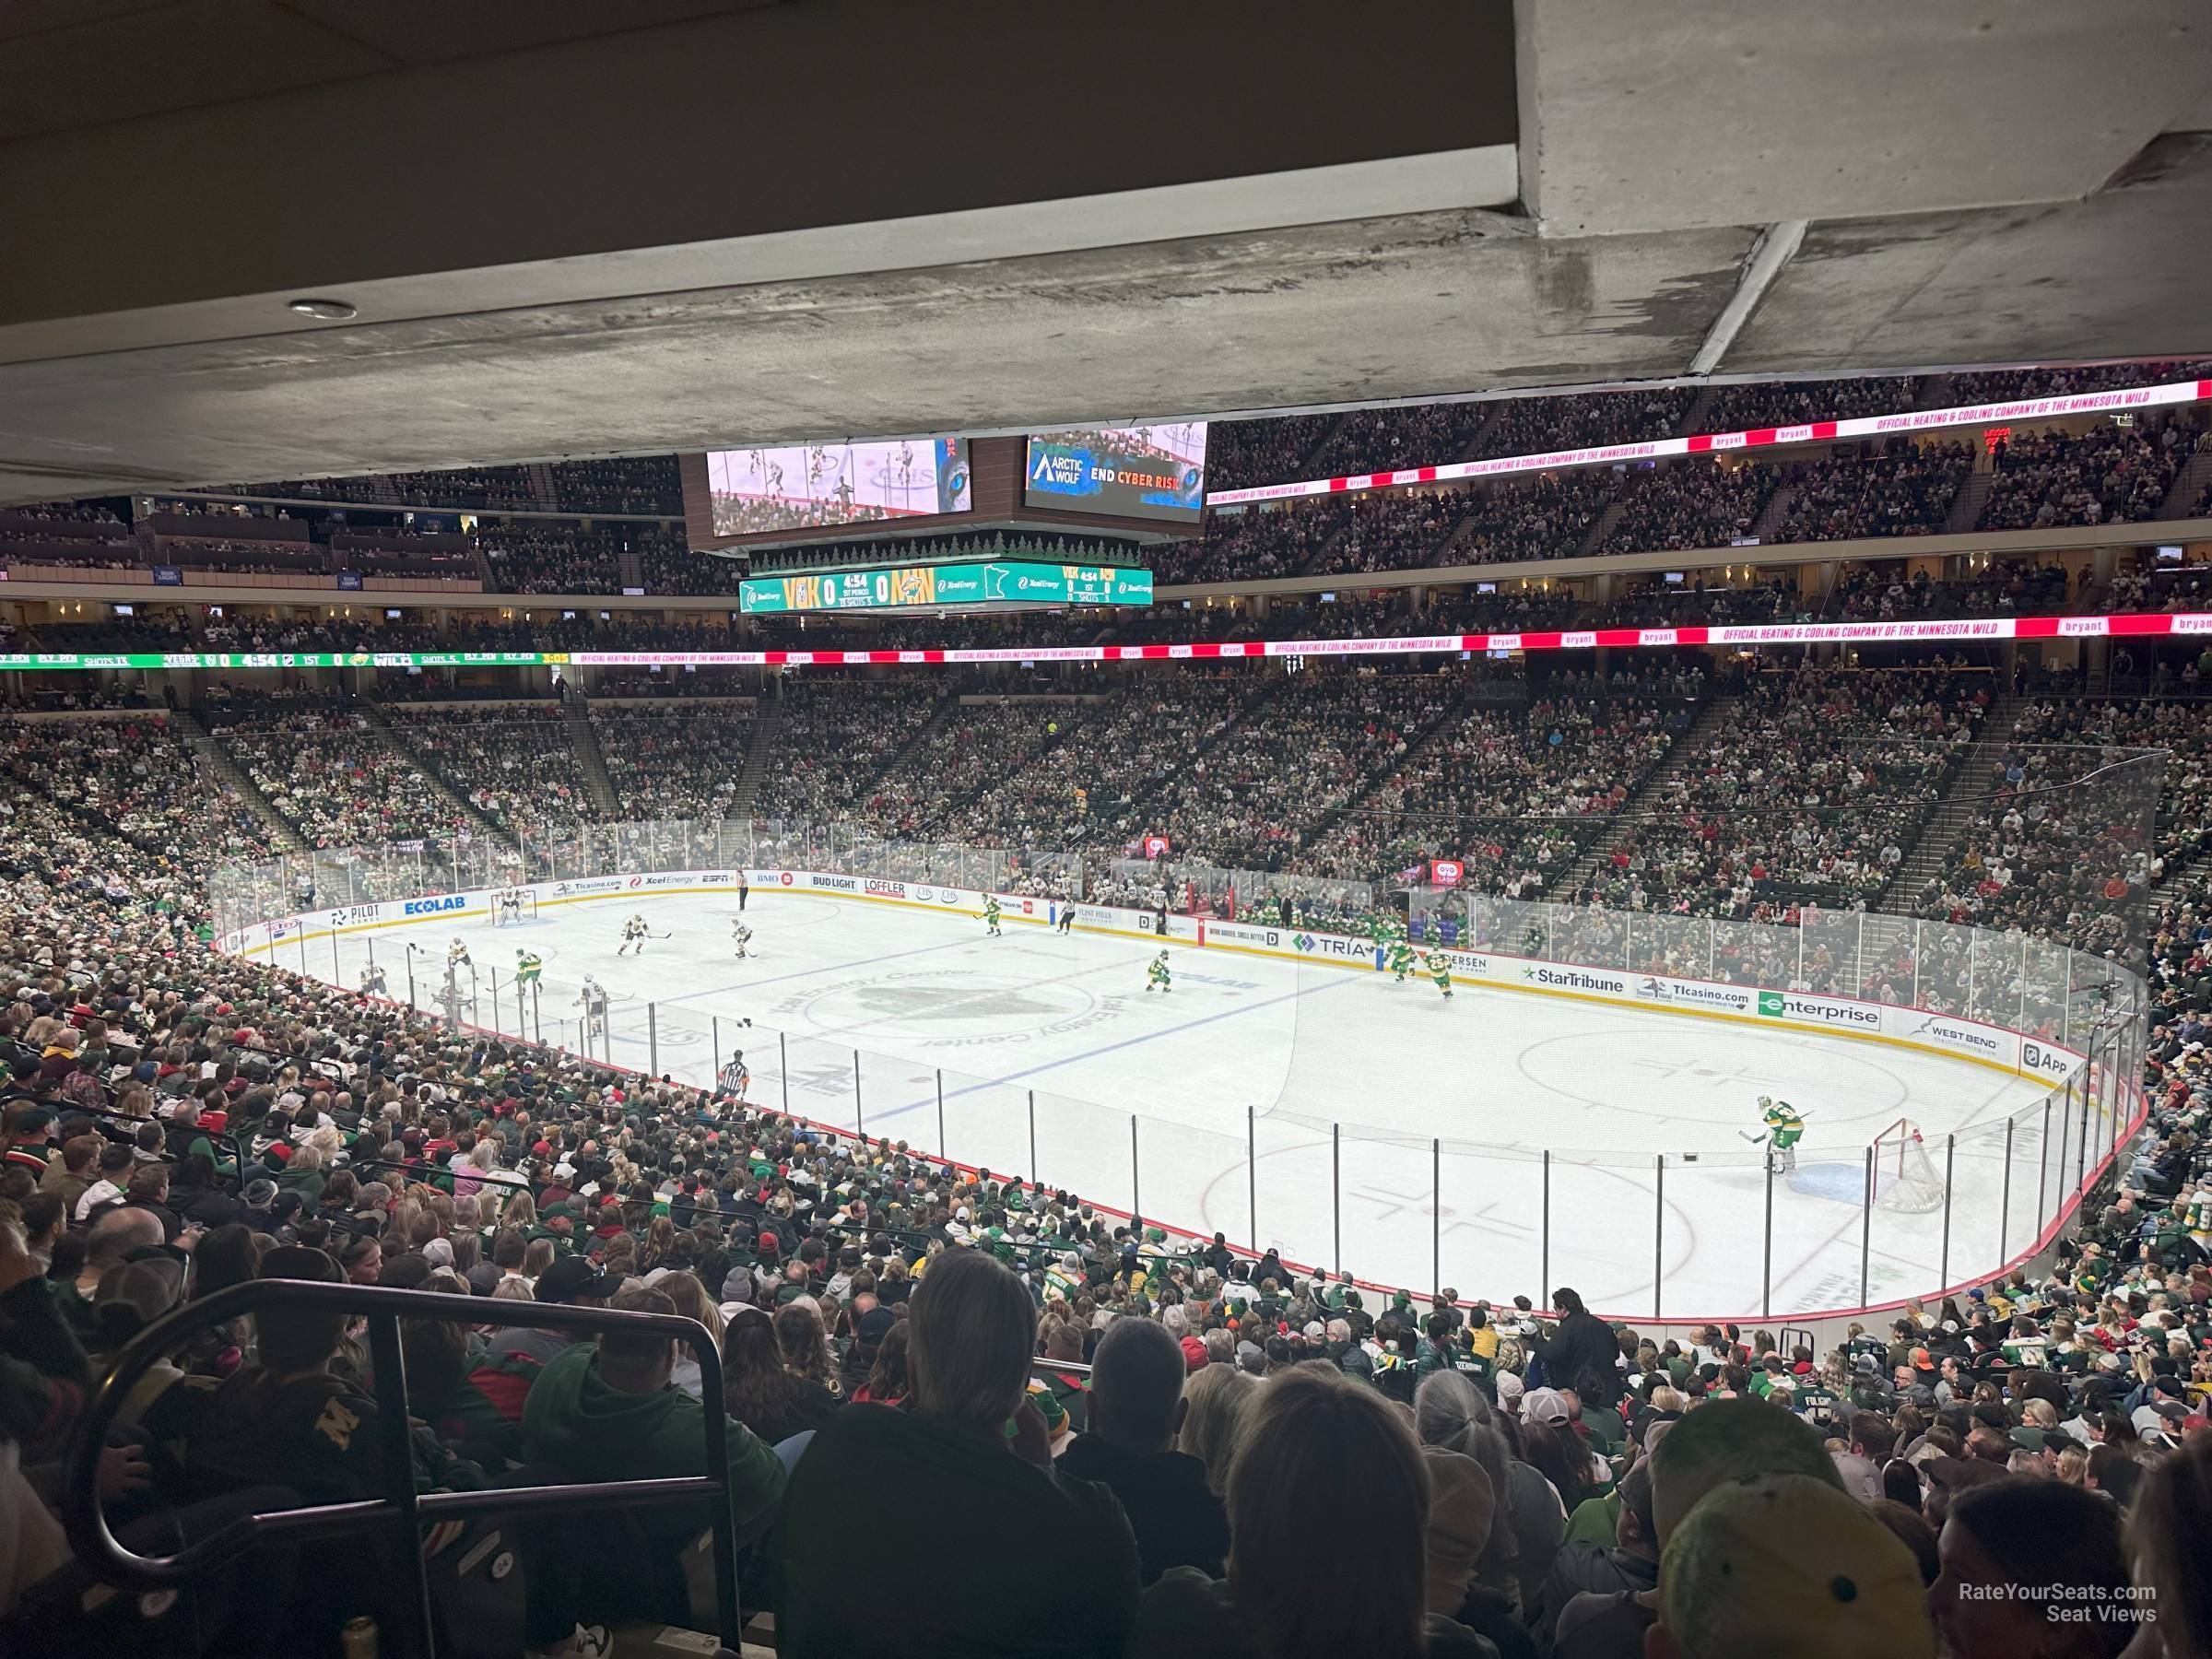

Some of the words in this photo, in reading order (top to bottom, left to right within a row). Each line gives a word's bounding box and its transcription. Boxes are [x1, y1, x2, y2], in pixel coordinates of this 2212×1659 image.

[1877, 418, 1912, 429] OFFICIAL
[1913, 415, 1947, 426] HEATING
[1950, 414, 1956, 422] &
[1958, 408, 1993, 420] COOLING
[1995, 404, 2036, 417] COMPANY
[2038, 402, 2050, 413] OF
[2052, 400, 2067, 411] THE
[2070, 394, 2121, 408] MINNESOTA
[2125, 391, 2150, 404] WILD
[1716, 435, 1742, 445] bryant
[1781, 429, 1808, 440] bryant
[1052, 456, 1084, 472] ARCTIC
[1465, 464, 1488, 474] OFFICIAL
[1490, 461, 1514, 471] HEATING
[1522, 457, 1547, 468] COOLING
[1548, 454, 1576, 465] COMPANY
[1578, 453, 1584, 462] OF
[1587, 452, 1598, 461] THE
[1600, 447, 1636, 457] MINNESOTA
[1638, 444, 1654, 453] WILD
[1055, 470, 1079, 485] WOLF
[1091, 467, 1115, 483] END
[1117, 471, 1153, 487] CYBER
[1155, 476, 1180, 490] RISK
[1349, 477, 1369, 487] bryant
[1395, 473, 1416, 482] bryant
[1080, 571, 1098, 581] 4:54
[823, 579, 835, 605] 0
[843, 575, 868, 588] 4:54
[876, 575, 888, 602] 0
[1078, 594, 1099, 602] SHOTS
[2065, 621, 2101, 633] bryant
[2180, 618, 2212, 629] bryan
[1644, 632, 1672, 642] bryant
[1724, 629, 1758, 640] OFFICIAL
[1760, 629, 1794, 639] HEATING
[1796, 629, 1803, 638] &
[1805, 627, 1841, 638] COOLING
[1841, 626, 1884, 637] COMPANY
[1886, 625, 1897, 636] OF
[1899, 625, 1915, 636] THE
[1917, 623, 1969, 635] MINNESOTA
[1972, 623, 1998, 634] WILD
[1493, 637, 1517, 645] bryant
[1566, 634, 1592, 643] bryant
[1276, 644, 1298, 653] OFFICIAL
[1299, 643, 1322, 653] HEATING
[1327, 642, 1350, 651] COOLING
[1351, 641, 1378, 651] COMPANY
[1400, 640, 1434, 649] MINNESOTA
[168, 654, 197, 664] VEGAS
[241, 654, 276, 667] 4:54
[302, 656, 320, 665] 1ST
[813, 877, 831, 887] BUD
[831, 878, 855, 890] LIGHT
[865, 879, 905, 894] LOFFLER
[917, 887, 933, 896] CHS
[942, 890, 957, 900] CHS
[350, 905, 380, 919] PILOT
[405, 897, 465, 914] ECOLAB
[1320, 936, 1366, 957] TRÍA
[1430, 959, 1443, 970] 25
[798, 977, 877, 999] Energy
[887, 970, 979, 981] Center
[1538, 970, 1624, 993] StarTribune
[1766, 996, 1878, 1023] enterprise
[1040, 1011, 1119, 1037] Energy
[924, 1032, 1030, 1047] Center
[1932, 1026, 1965, 1040] WEST
[1965, 1034, 1996, 1049] BEND
[2041, 1053, 2066, 1073] App
[315, 1395, 359, 1452] M
